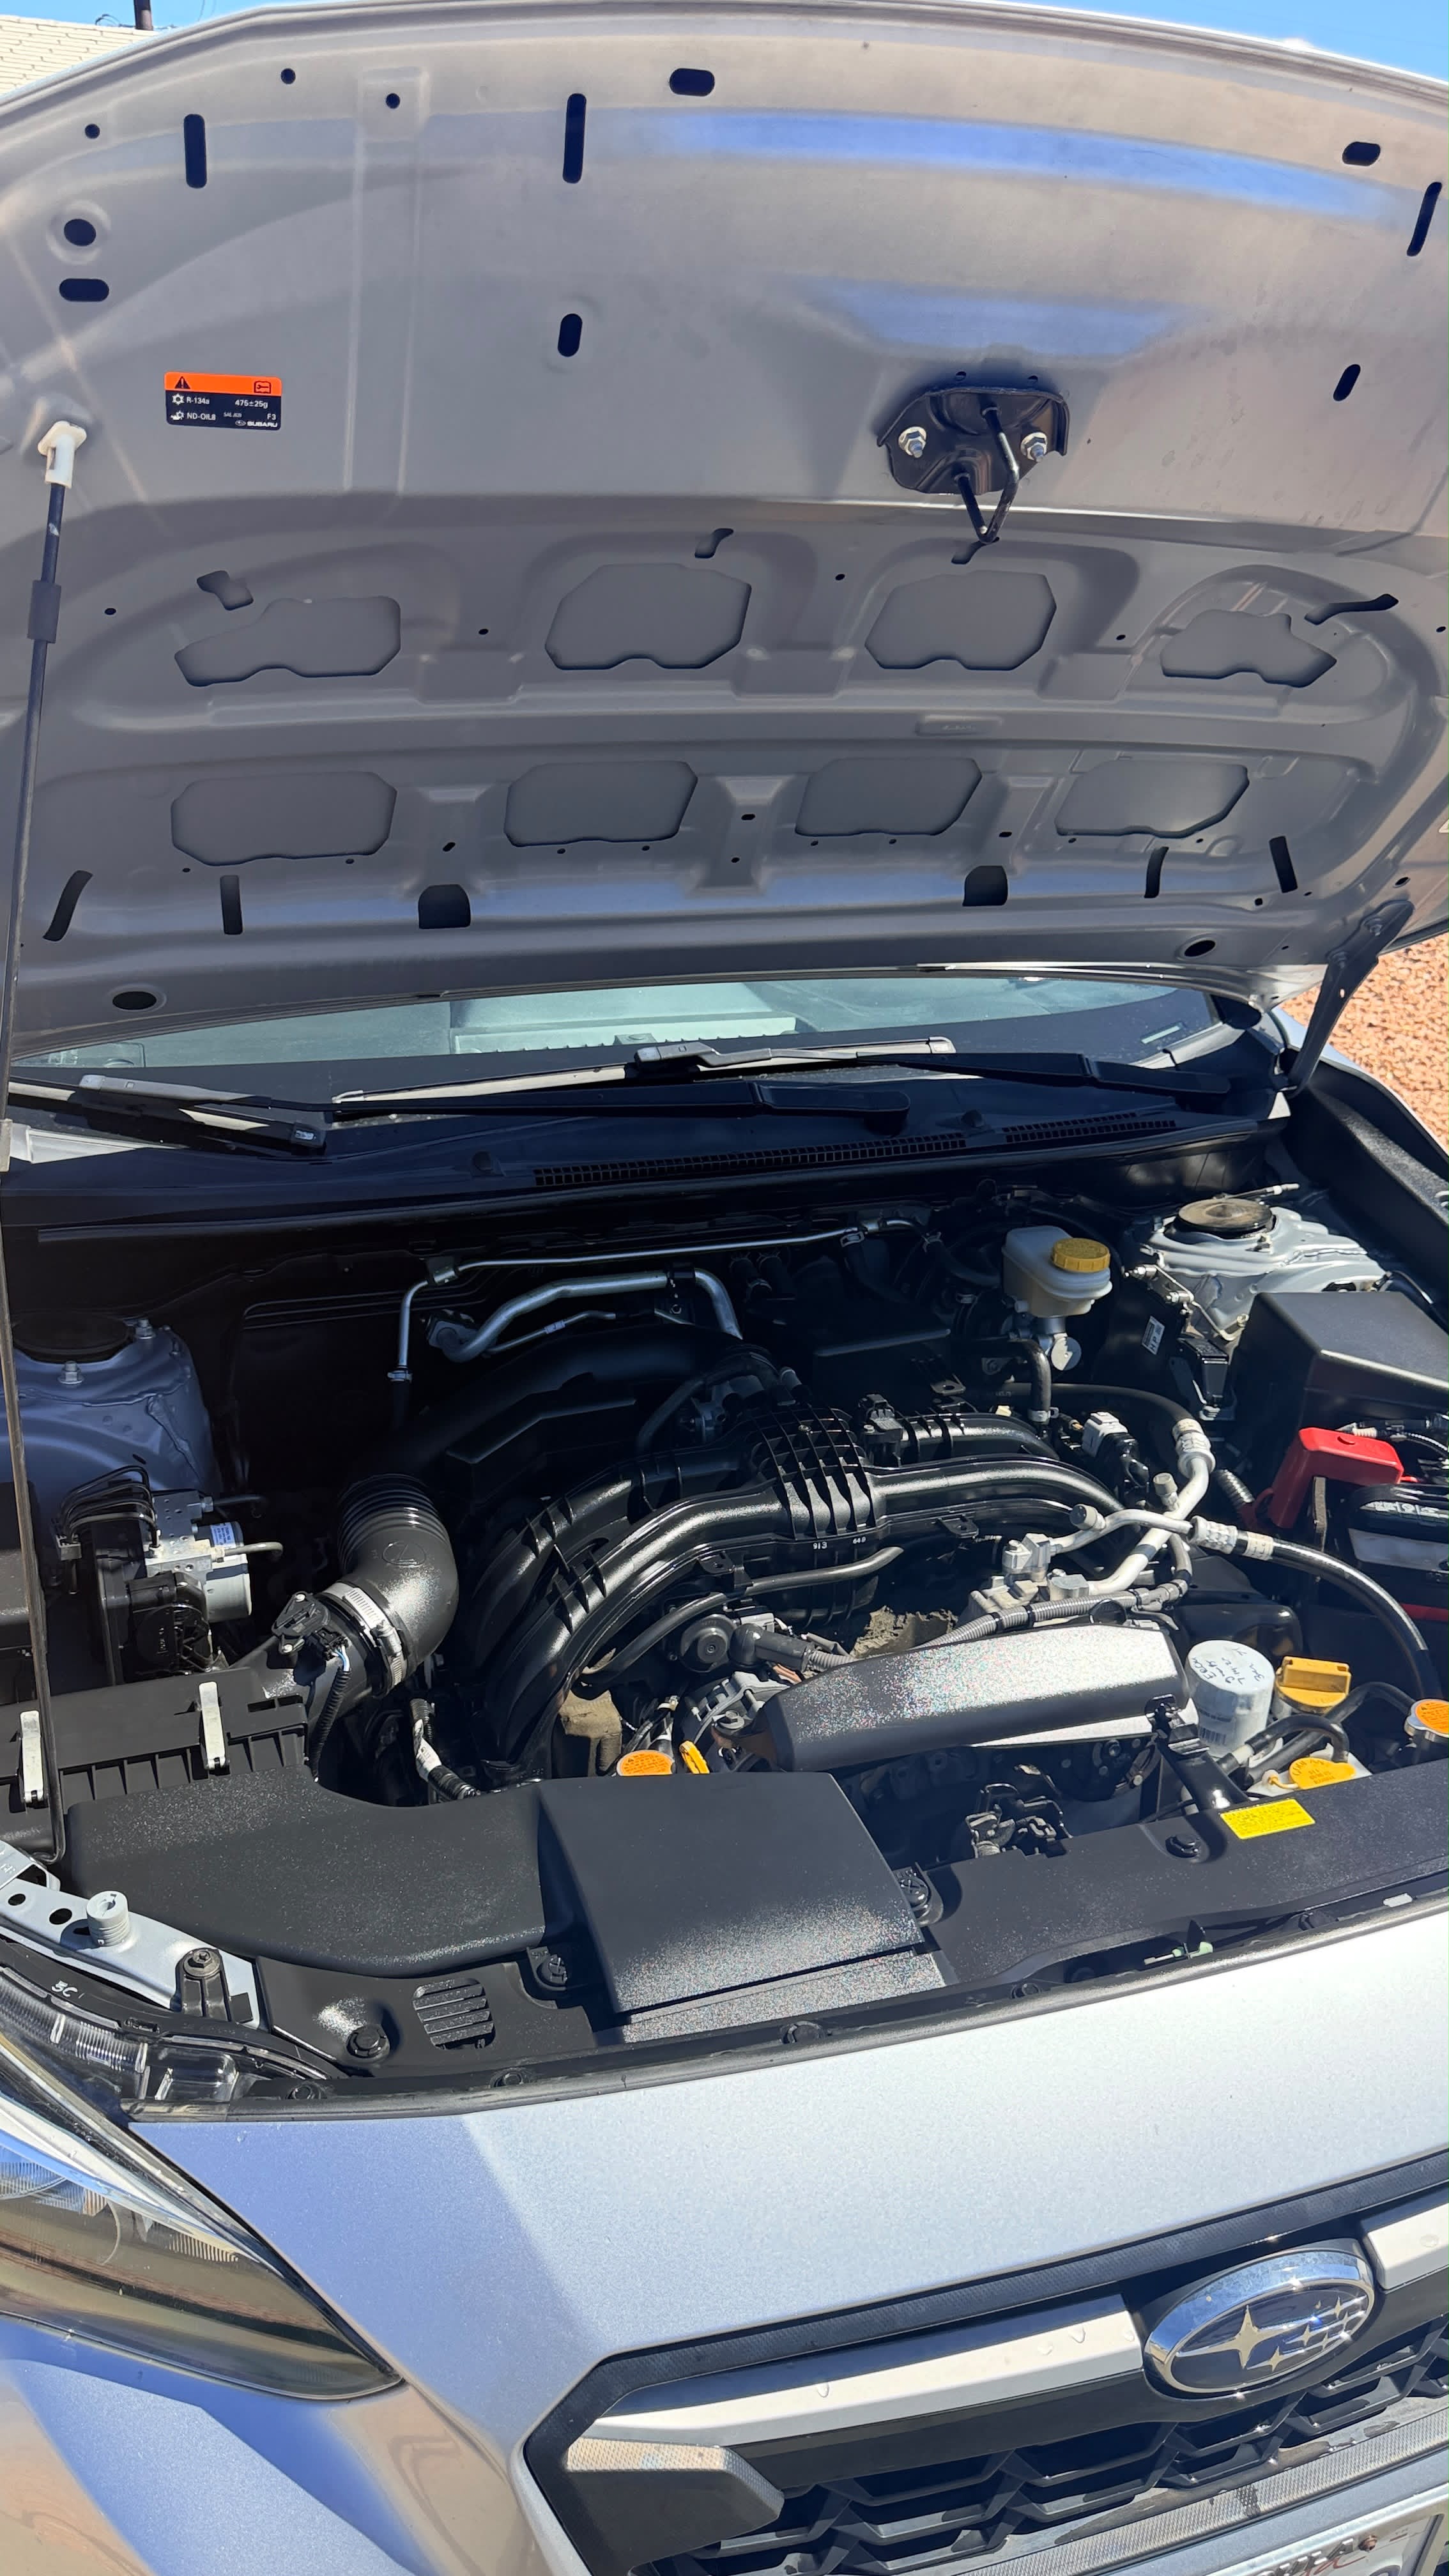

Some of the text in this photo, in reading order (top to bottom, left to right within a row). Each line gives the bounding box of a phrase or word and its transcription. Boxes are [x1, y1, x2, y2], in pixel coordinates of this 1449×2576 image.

[186, 396, 268, 409] R-134a 475±25g
[187, 412, 217, 421] ND-OIL8
[813, 1541, 828, 1550] 913
